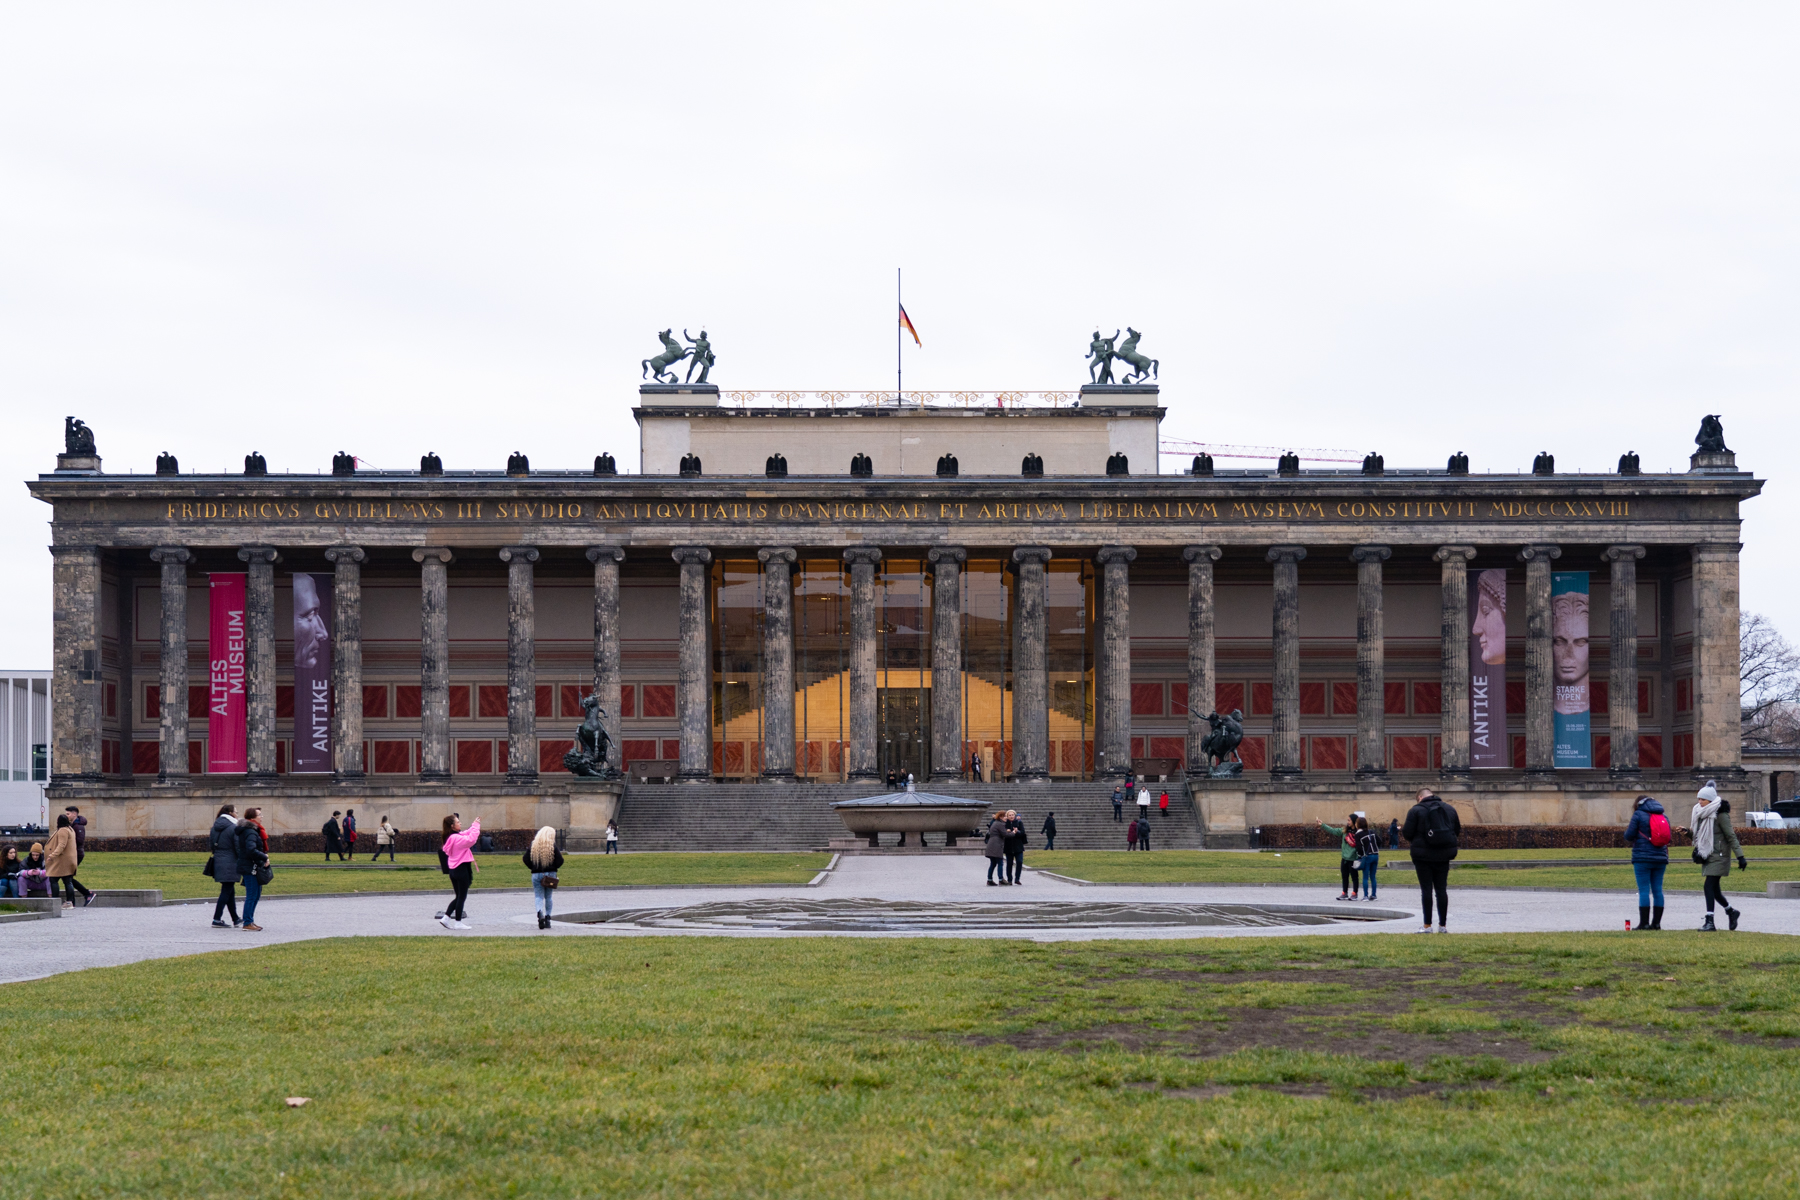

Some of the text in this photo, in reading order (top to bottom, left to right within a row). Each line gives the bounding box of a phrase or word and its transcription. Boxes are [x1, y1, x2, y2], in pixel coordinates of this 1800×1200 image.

[167, 501, 1630, 520] FRIDERICVS GVILELMVS III STVDIO ANTIQVITATIS OMNIGENAE ET ARTIVM LIBERALIVM MVSEVM CONSTITVIT MDCCCXXVIII
[228, 610, 244, 694] MUSEUM
[211, 660, 228, 716] ALTES
[312, 679, 328, 752] ANTIKE
[1473, 675, 1489, 748] ANTIKE
[1556, 693, 1581, 701] TYPEN
